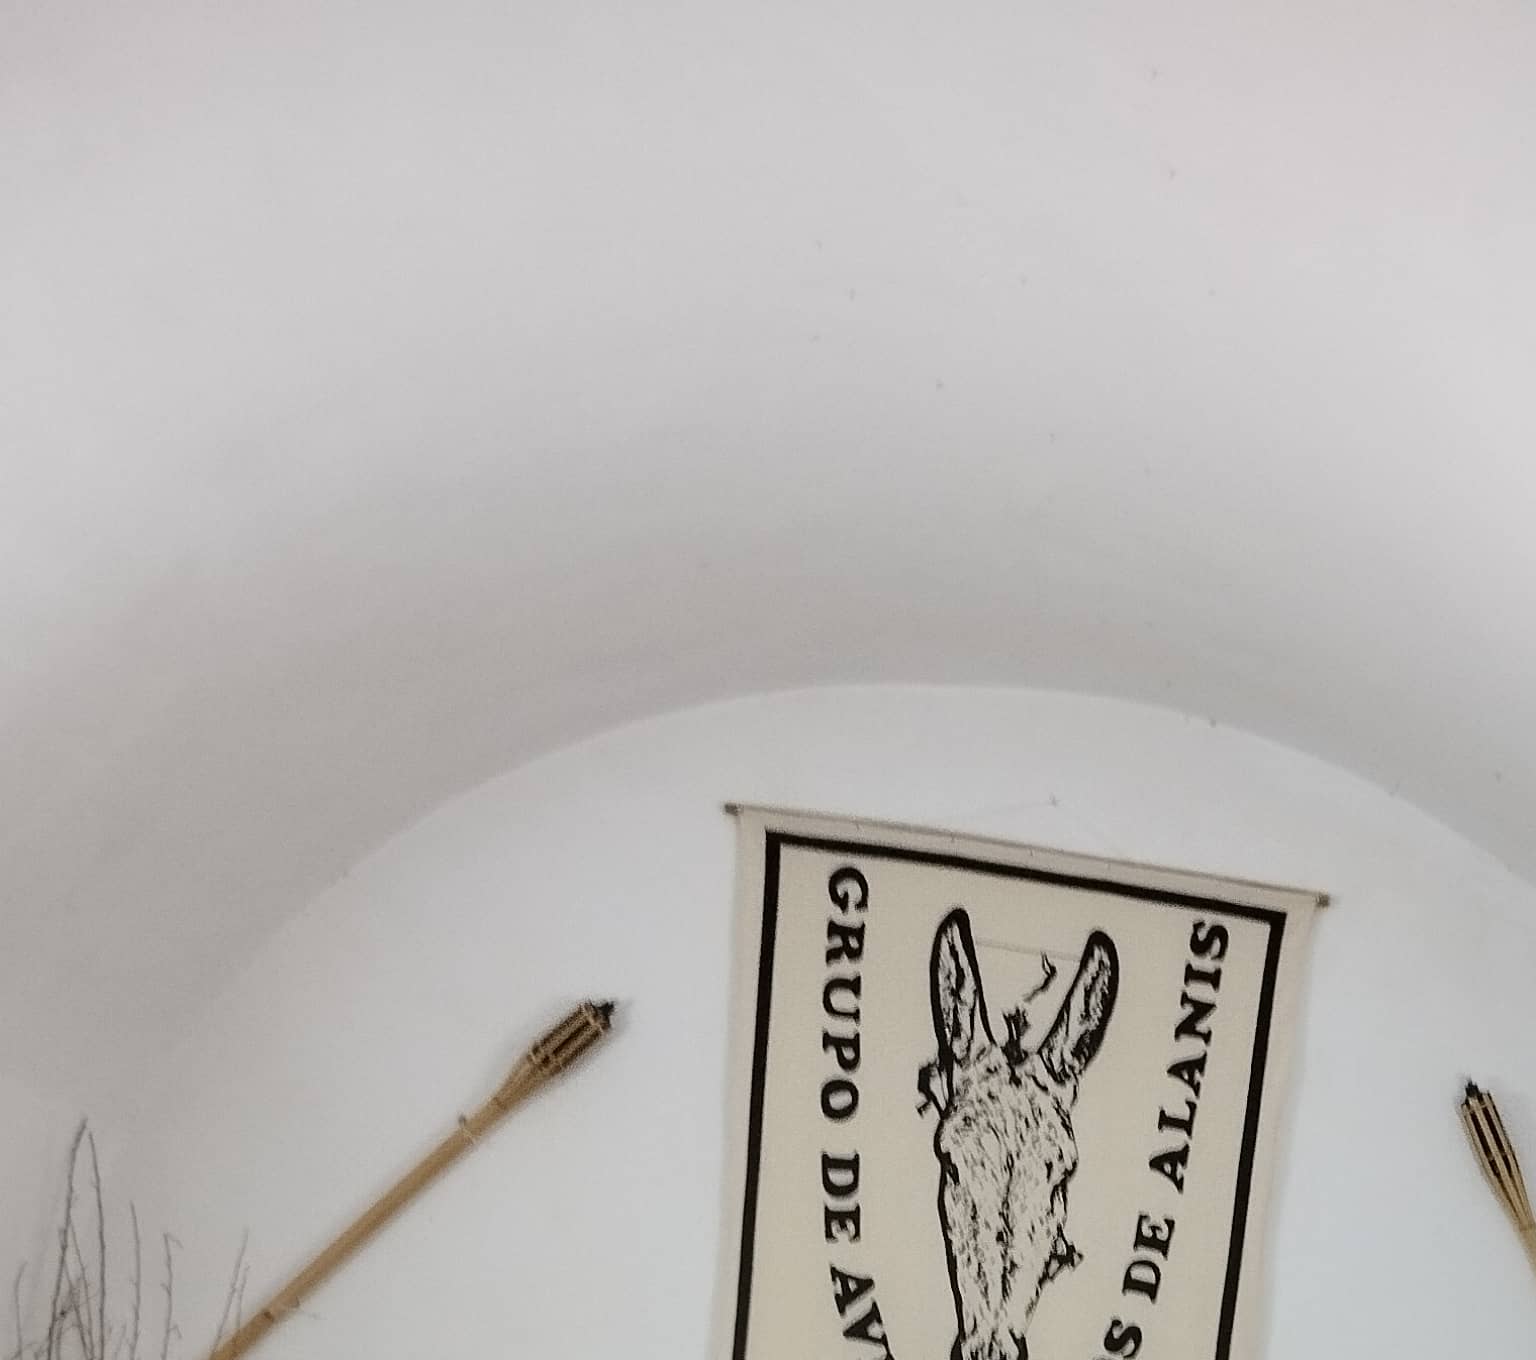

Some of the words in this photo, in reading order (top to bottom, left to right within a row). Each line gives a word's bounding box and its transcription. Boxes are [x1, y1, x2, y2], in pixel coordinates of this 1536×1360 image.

[820, 865, 869, 1122] GRUPO
[1148, 919, 1229, 1193] ALANIS
[821, 1151, 861, 1242] DE
[1121, 1214, 1176, 1303] DE
